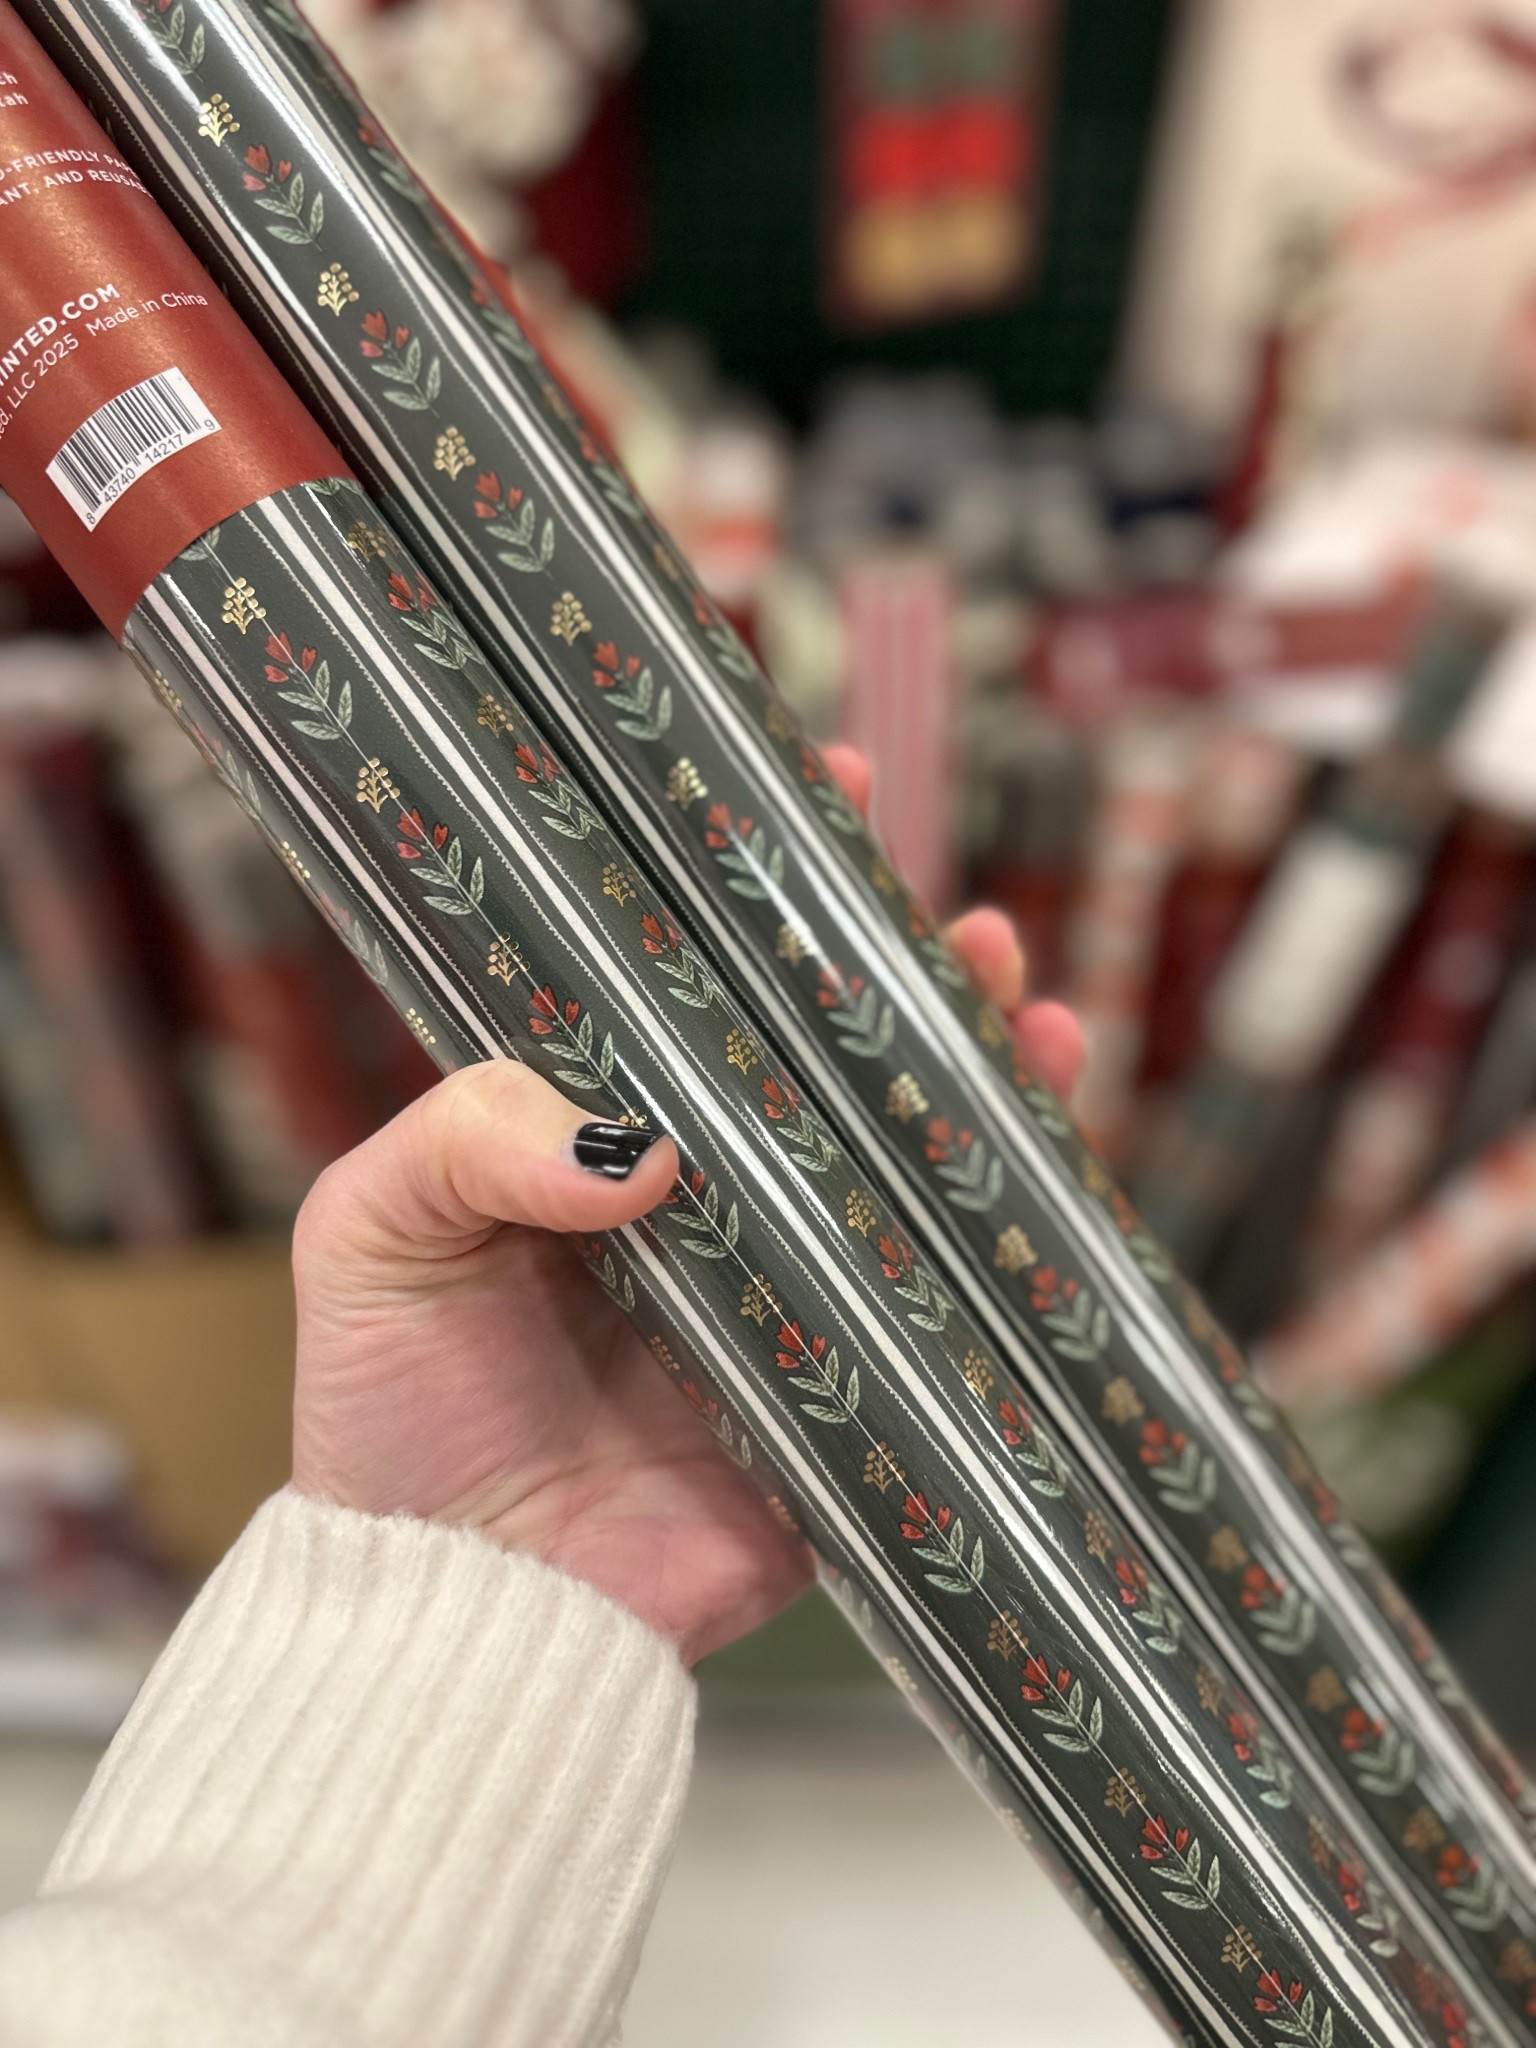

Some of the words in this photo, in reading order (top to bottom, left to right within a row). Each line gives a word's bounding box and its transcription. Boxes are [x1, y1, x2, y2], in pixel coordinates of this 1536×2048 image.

[43, 170, 84, 189] AND
[0, 283, 121, 387] INTED.COM
[7, 372, 36, 409] LLC
[33, 333, 79, 377] 2025
[85, 305, 140, 337] Made
[141, 298, 160, 314] in
[161, 292, 208, 308] China
[86, 512, 97, 525] 8
[103, 467, 136, 504] 43740
[144, 434, 184, 464] 14217
[204, 419, 216, 432] 9
